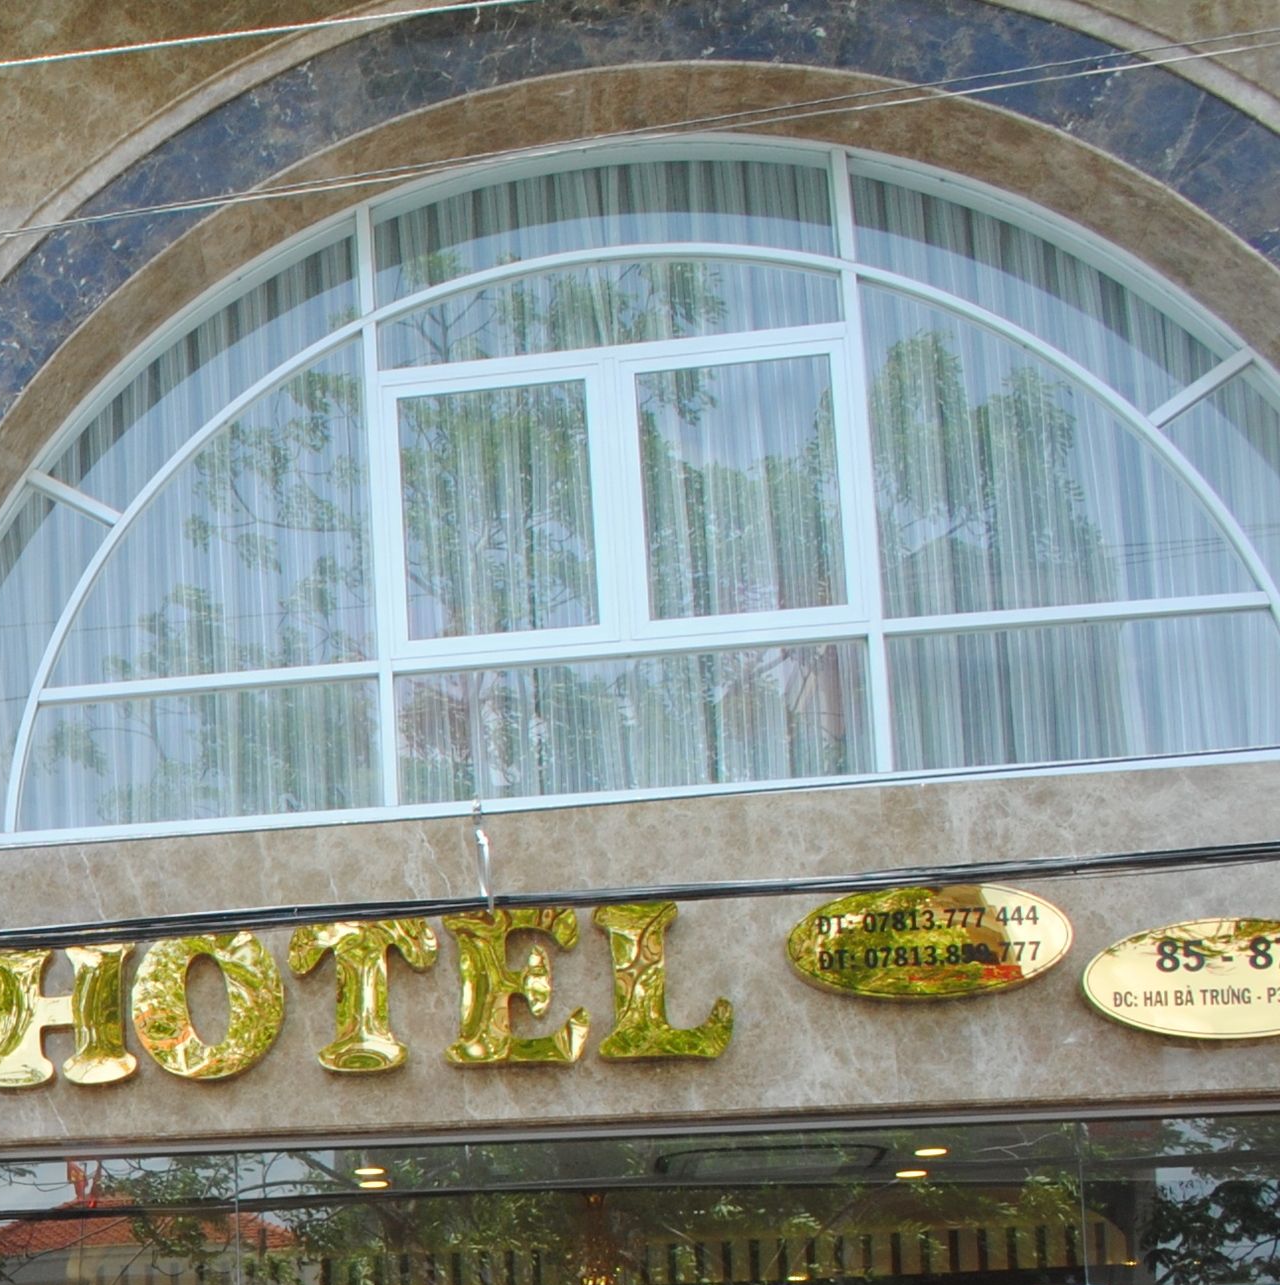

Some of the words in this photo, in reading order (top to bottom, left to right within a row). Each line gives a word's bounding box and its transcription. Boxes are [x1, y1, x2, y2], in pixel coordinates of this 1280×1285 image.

[995, 905, 1039, 926] 444
[1156, 940, 1205, 972] 85
[1249, 935, 1280, 970] 8
[1144, 990, 1168, 1006] HAI
[1174, 985, 1194, 1006] BÀ
